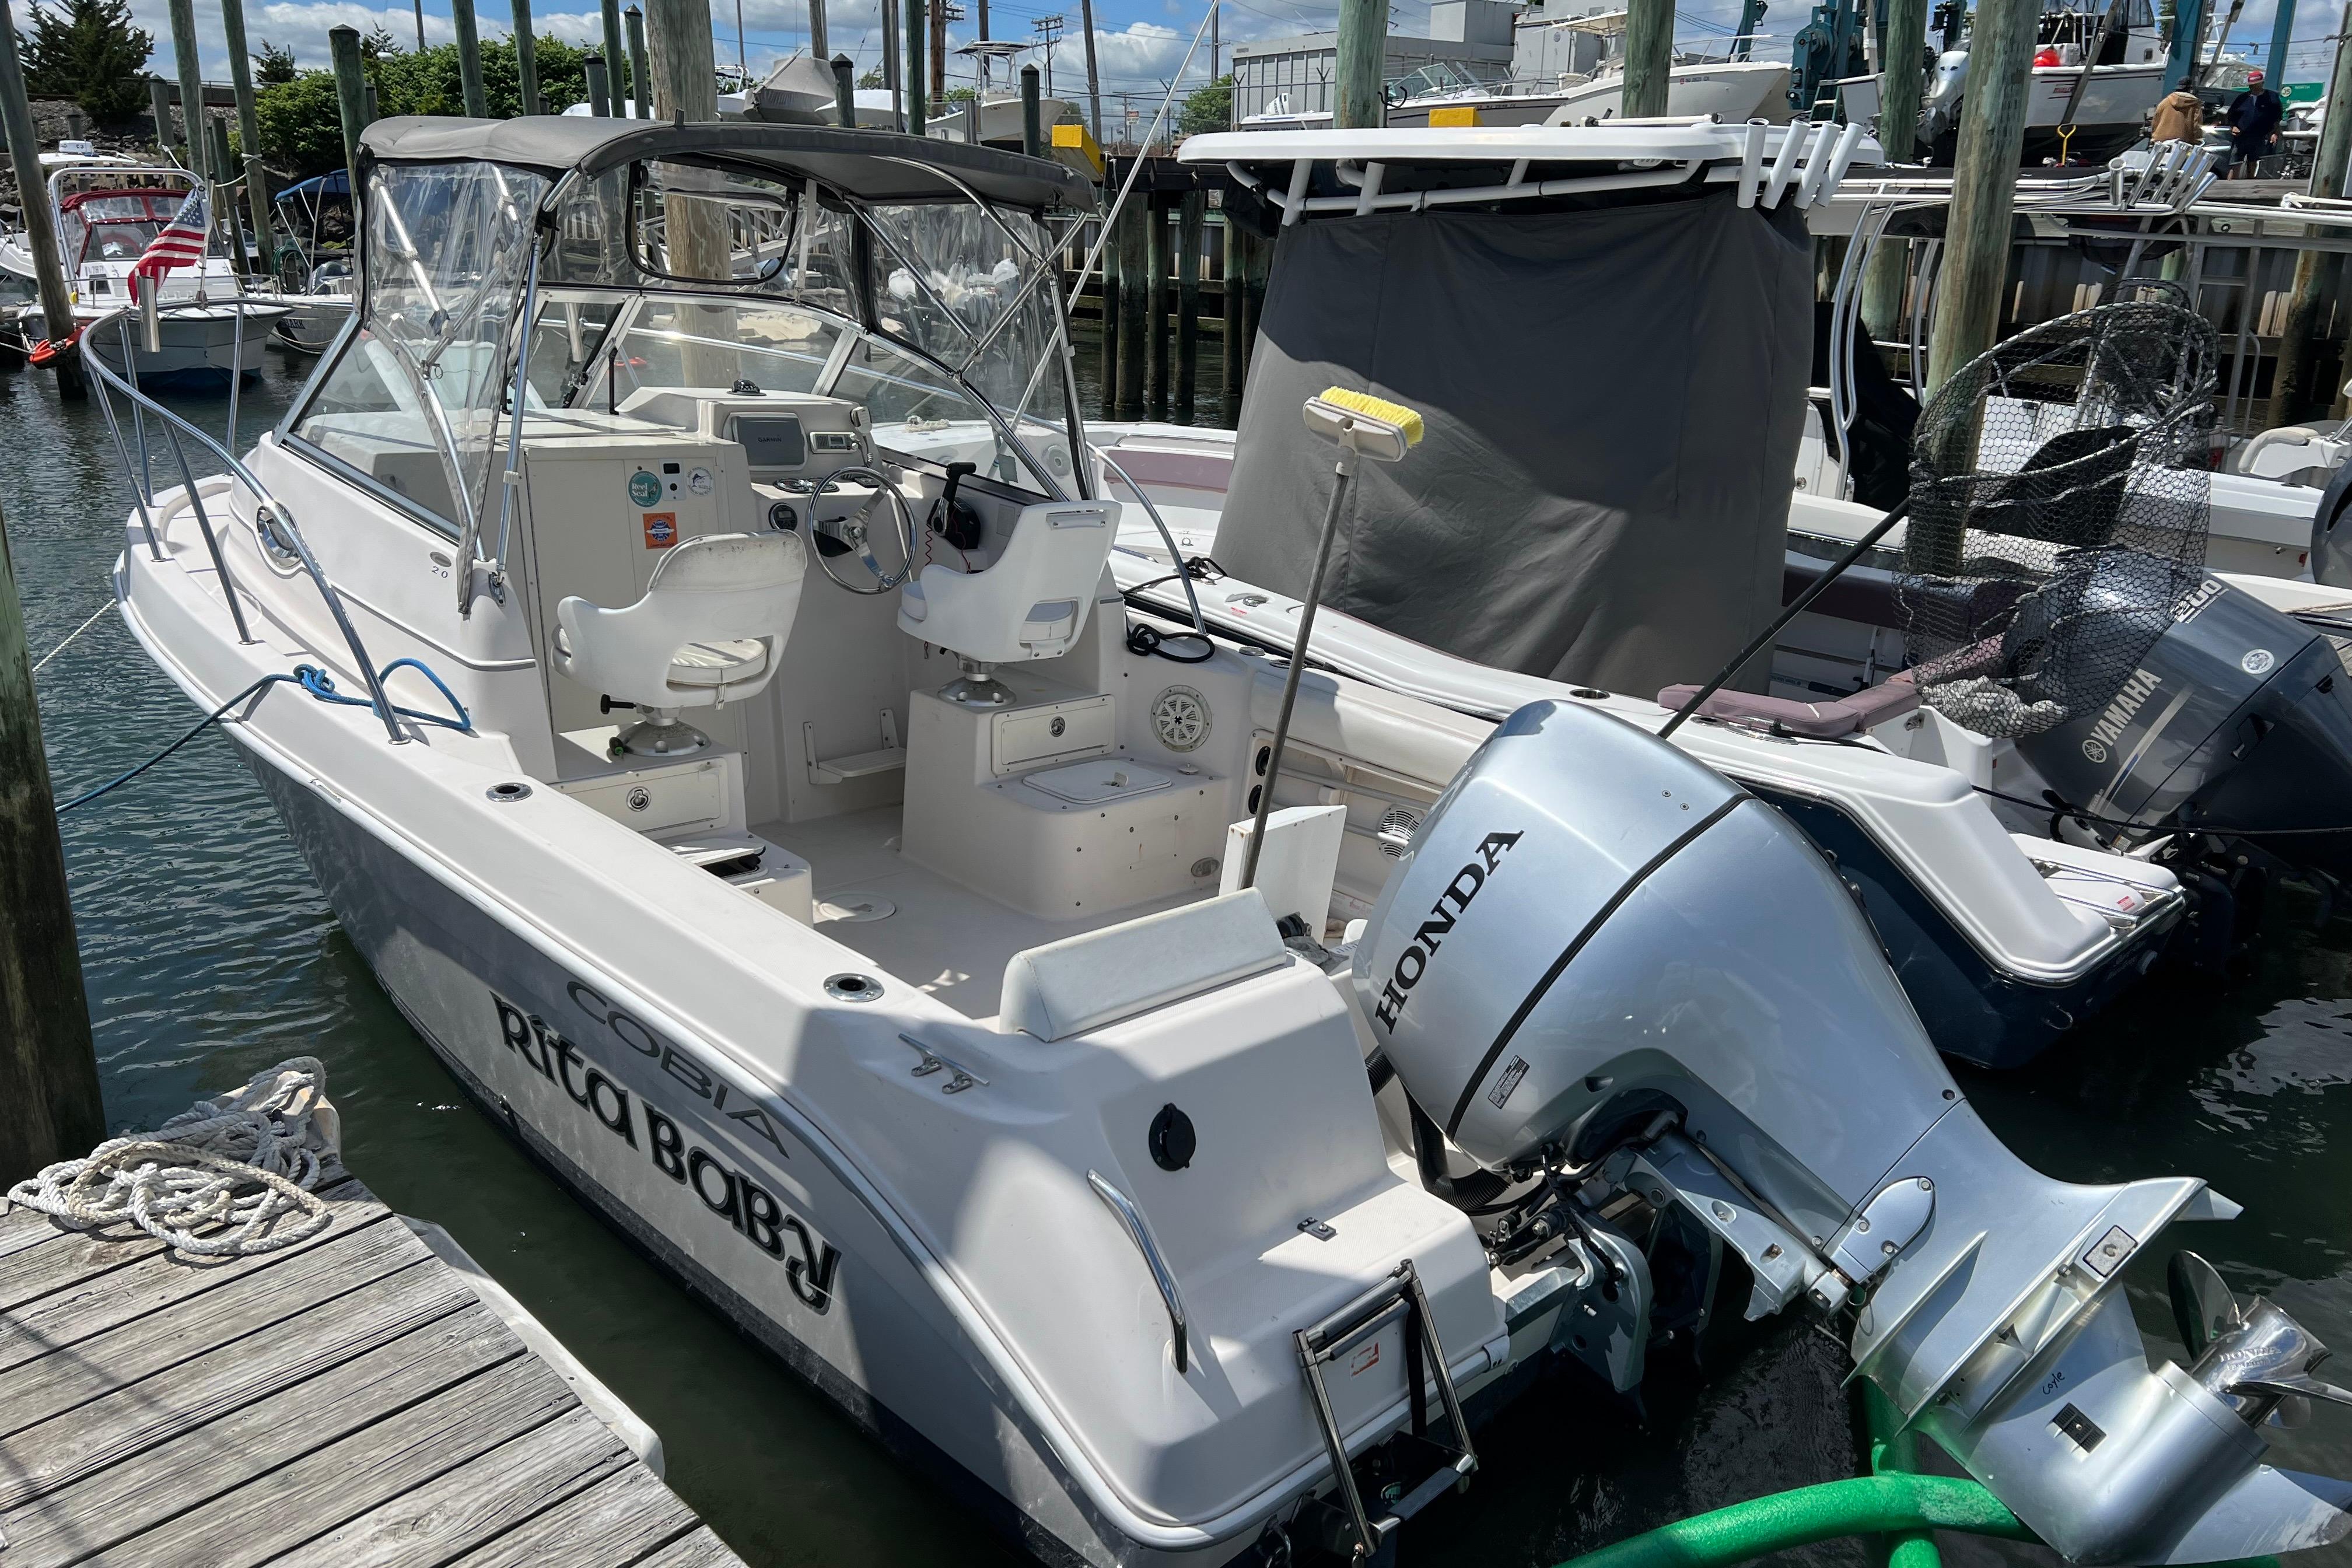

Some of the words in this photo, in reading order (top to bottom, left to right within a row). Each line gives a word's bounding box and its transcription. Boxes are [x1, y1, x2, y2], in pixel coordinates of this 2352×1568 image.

[632, 482, 648, 491] Reel
[2090, 668, 2162, 746] YAMAHA
[1375, 830, 1525, 1035] HONDA
[566, 980, 791, 1159] COBIA
